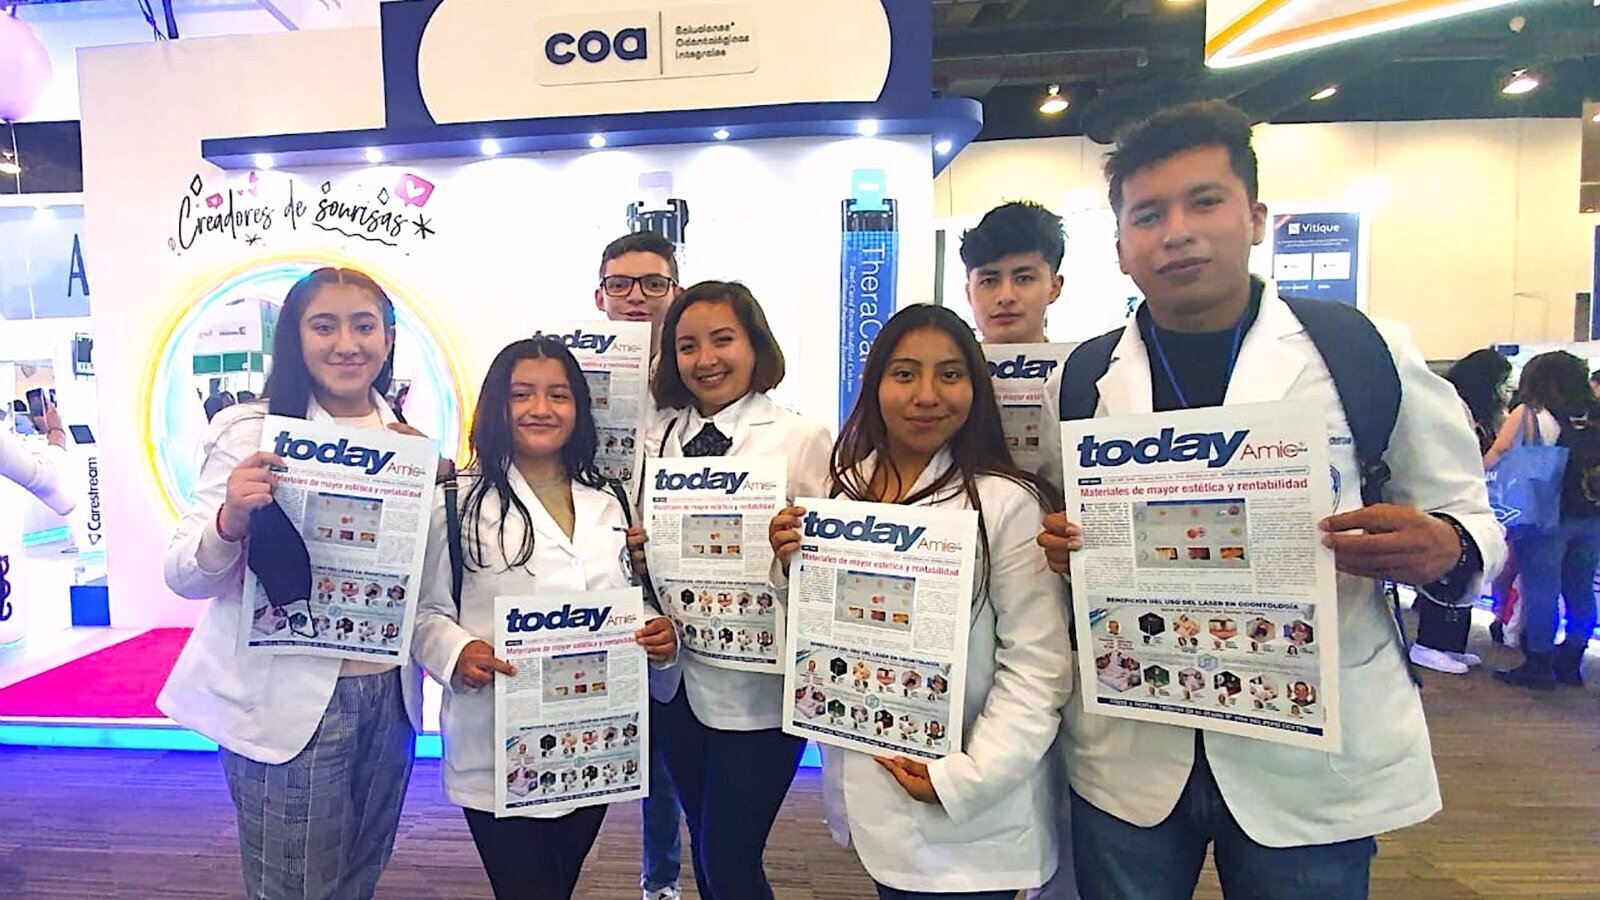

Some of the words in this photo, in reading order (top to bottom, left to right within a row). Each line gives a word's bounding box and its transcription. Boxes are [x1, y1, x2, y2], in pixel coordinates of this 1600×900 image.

[545, 27, 647, 65] coa
[178, 188, 275, 249] Creadores
[284, 180, 306, 230] de
[1302, 223, 1340, 234] Vitique
[275, 431, 396, 475] today
[1078, 427, 1250, 468] today
[88, 456, 102, 531] Carestream
[655, 467, 749, 495] today
[1081, 486, 1130, 497] Materiales
[1132, 486, 1145, 495] de
[1147, 484, 1179, 495] mayor
[1182, 482, 1225, 493] estética
[1227, 484, 1234, 493] y
[1237, 479, 1308, 491] rentabilidad
[804, 511, 926, 551] today
[803, 553, 837, 564] Materiales
[839, 557, 848, 565] de
[849, 559, 872, 568] mayor
[874, 561, 903, 571] estética
[912, 565, 960, 577] rentabilidad
[506, 604, 612, 633] today
